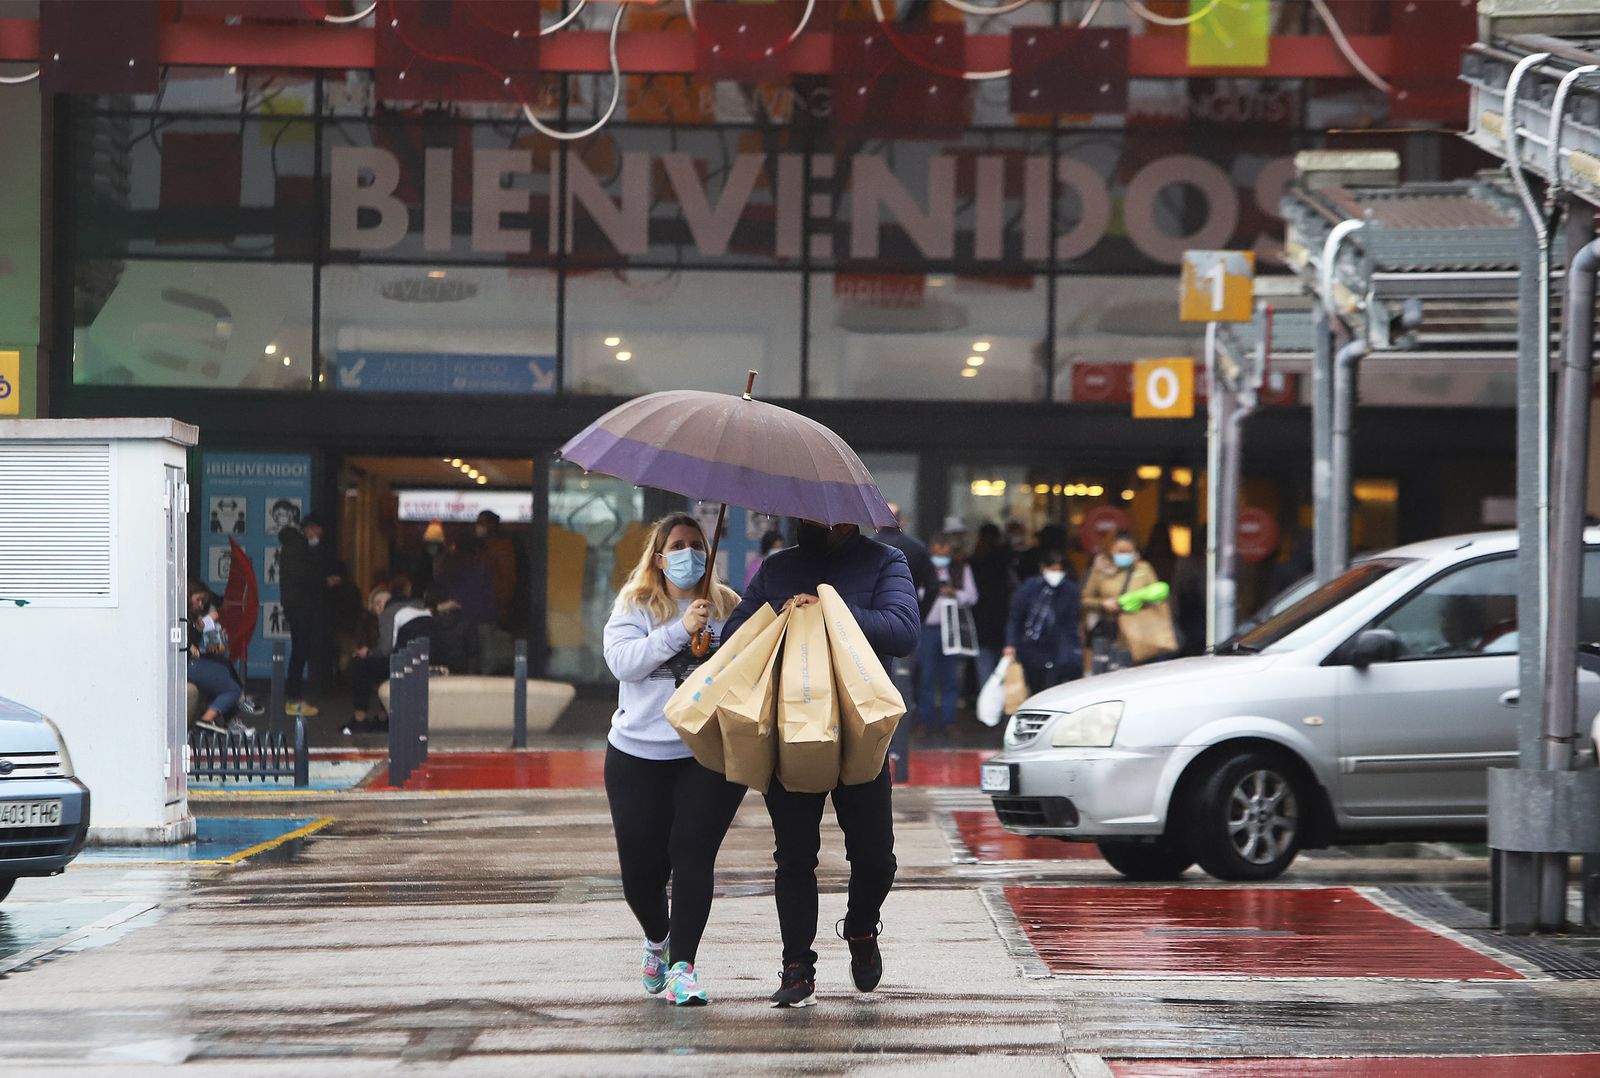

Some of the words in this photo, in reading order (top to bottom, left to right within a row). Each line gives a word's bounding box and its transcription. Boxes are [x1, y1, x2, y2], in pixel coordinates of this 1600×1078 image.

[1203, 262, 1224, 312] 1
[1146, 367, 1180, 410] 0
[206, 463, 307, 477] ¡BIENVENIDO!
[29, 803, 58, 824] FHC
